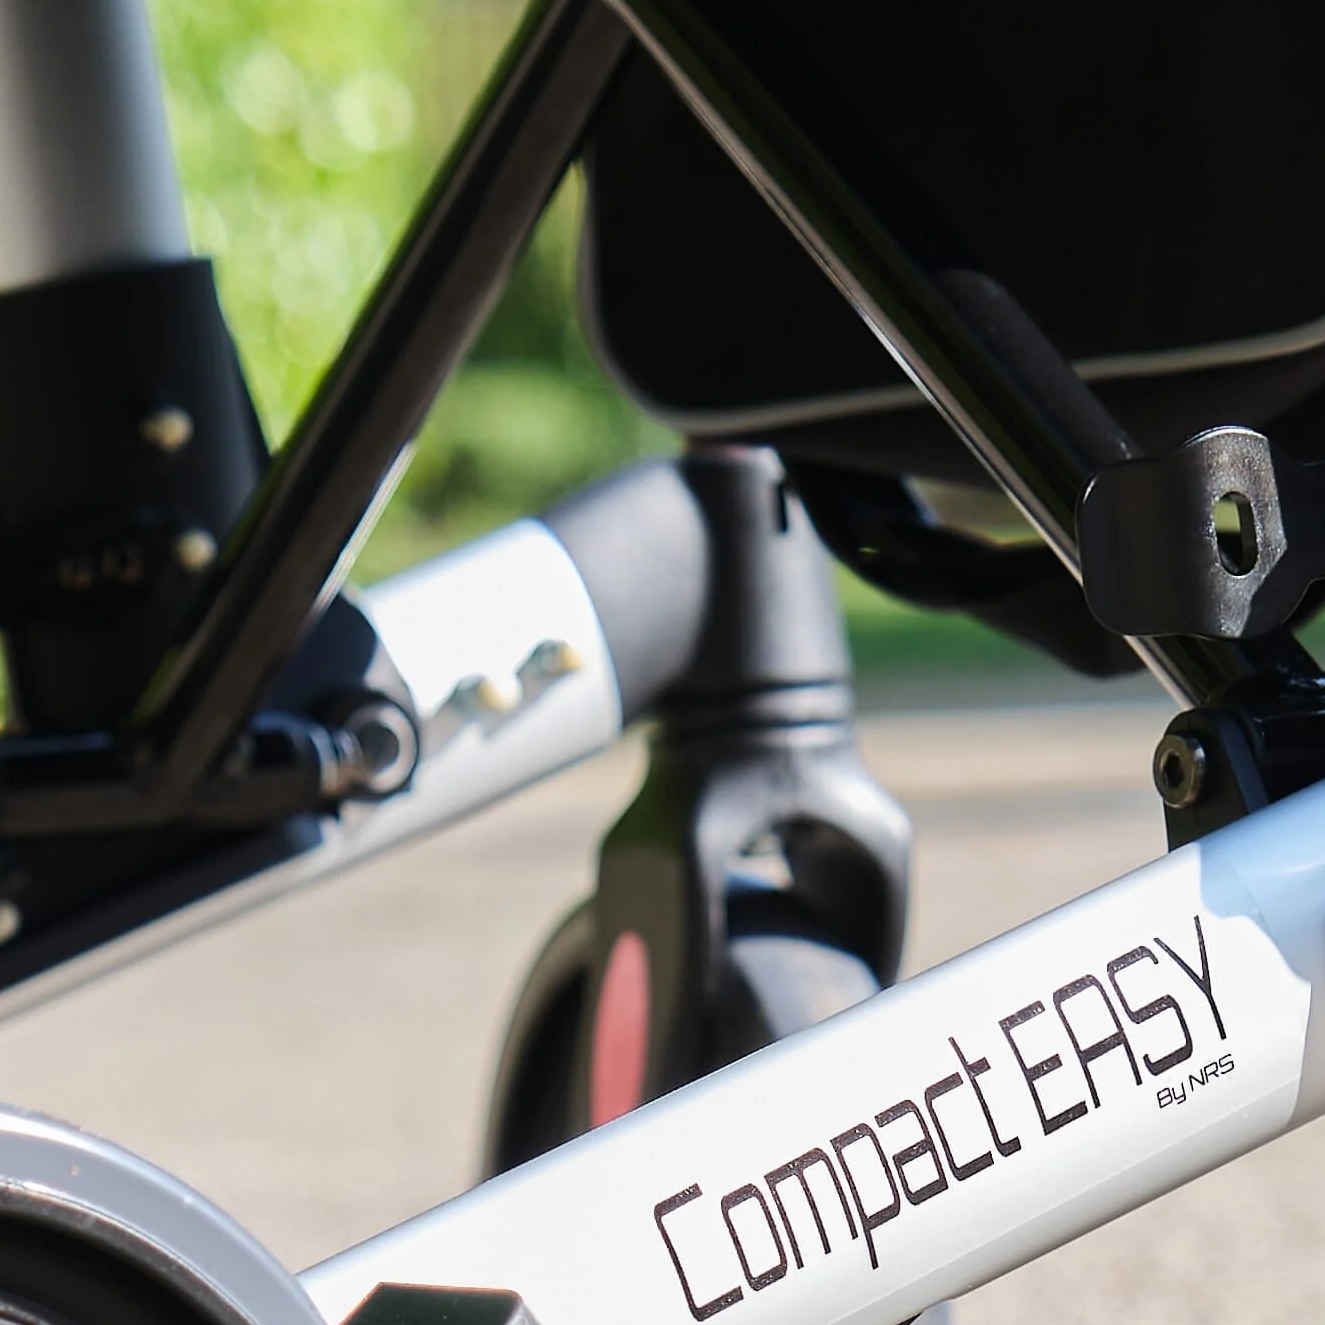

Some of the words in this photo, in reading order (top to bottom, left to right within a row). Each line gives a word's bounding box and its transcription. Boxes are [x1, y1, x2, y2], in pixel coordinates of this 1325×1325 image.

[654, 1036, 1022, 1322] Compact
[998, 915, 1228, 1136] EASY
[1156, 1082, 1187, 1109] By
[1189, 1054, 1235, 1092] NRS
